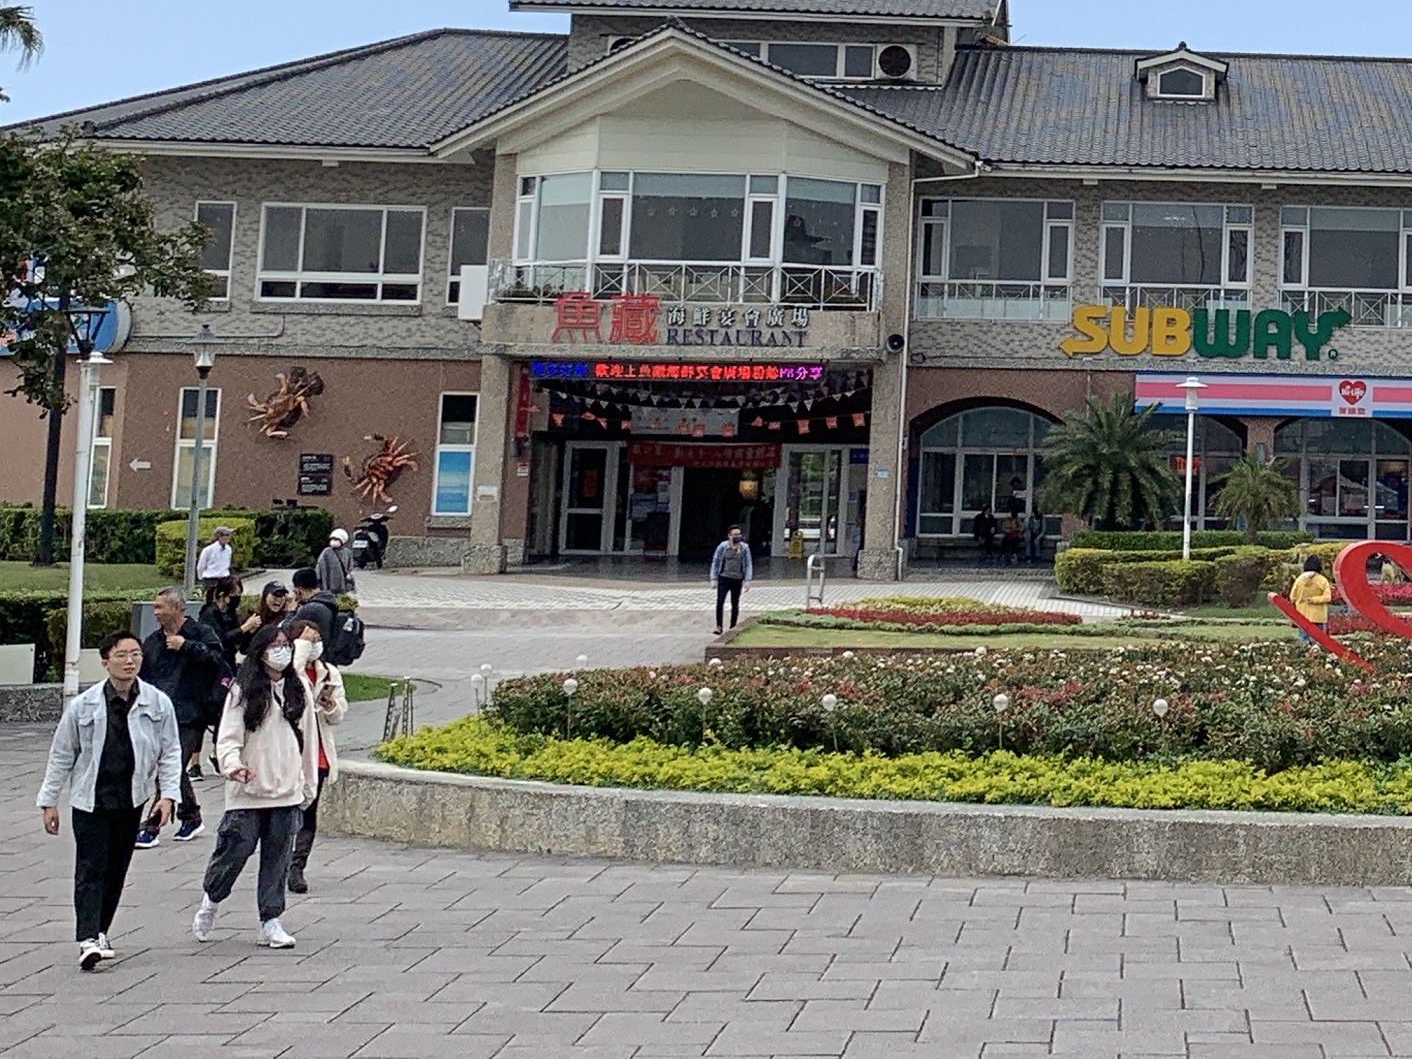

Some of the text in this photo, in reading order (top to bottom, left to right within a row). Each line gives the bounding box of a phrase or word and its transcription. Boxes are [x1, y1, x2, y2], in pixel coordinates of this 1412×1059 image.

[551, 290, 661, 344] 魚藏
[667, 306, 809, 329] 海鮮宴會廣場
[1059, 304, 1353, 361] SUBWAY
[666, 329, 808, 346] RESTAURANT
